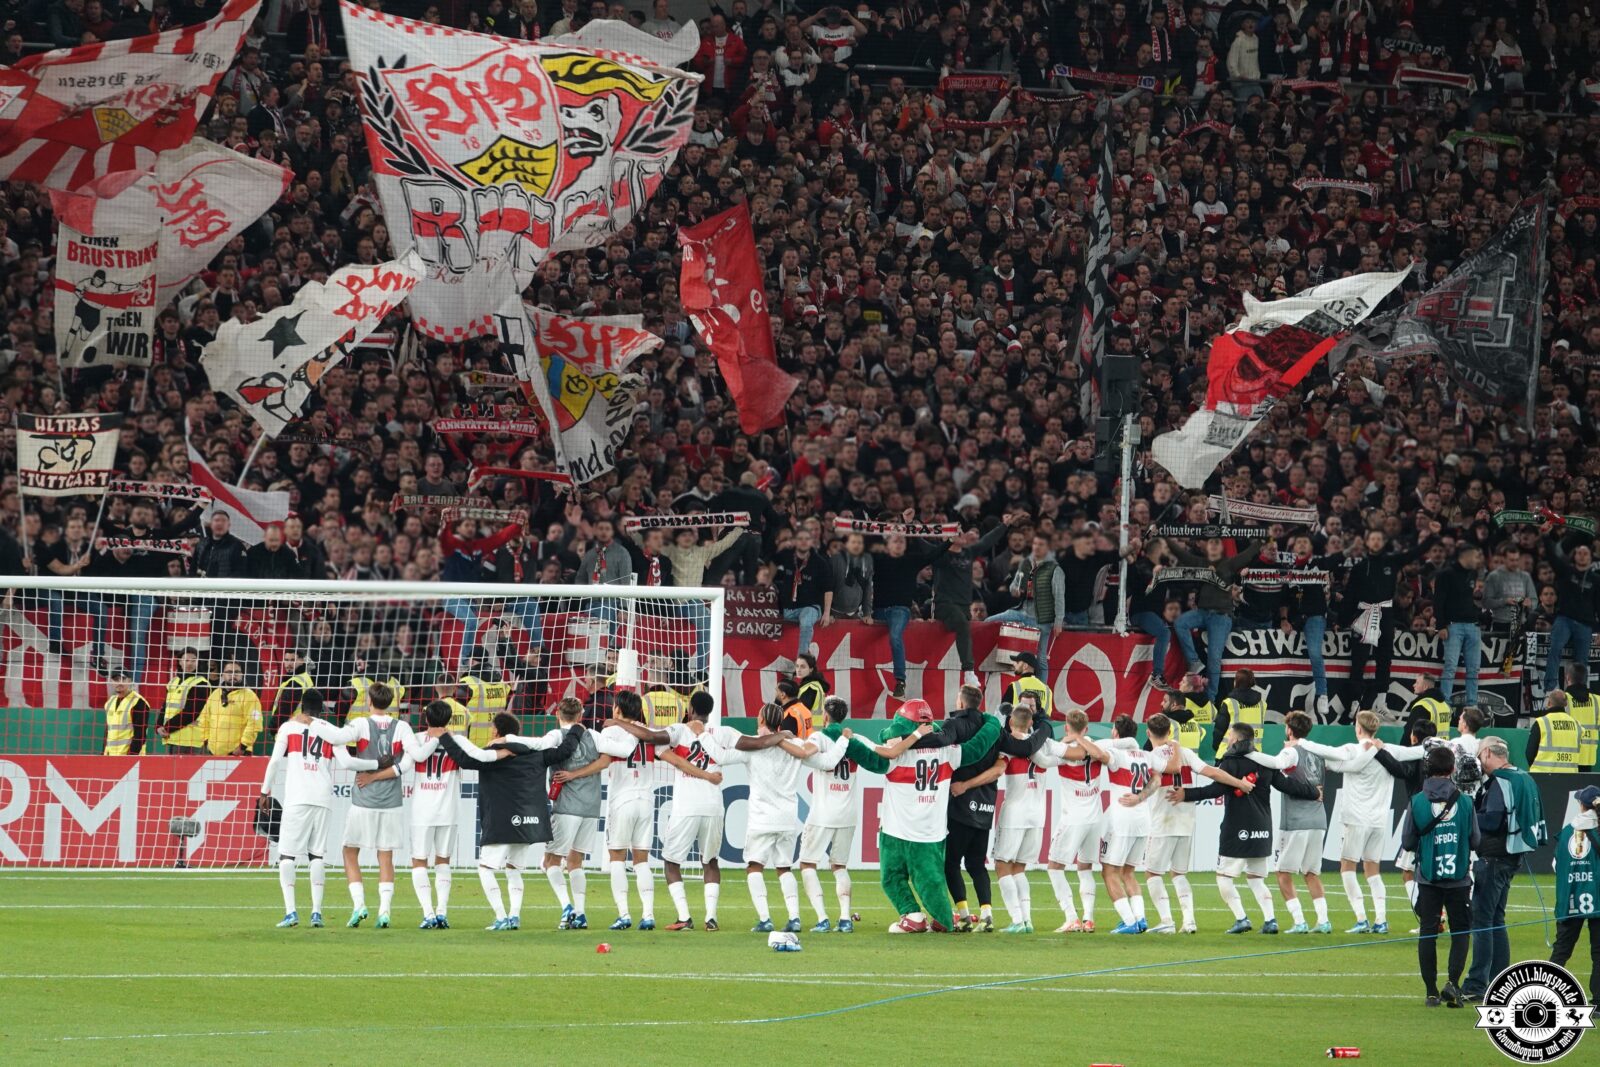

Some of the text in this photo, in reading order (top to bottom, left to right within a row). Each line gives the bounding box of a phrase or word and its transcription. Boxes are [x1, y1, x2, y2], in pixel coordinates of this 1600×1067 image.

[462, 134, 482, 151] 18
[106, 332, 148, 358] WIR
[34, 417, 101, 432] ULTRAS
[20, 472, 109, 489] STUTTGART
[640, 513, 735, 528] COMMANDO
[485, 687, 507, 700] SECURITY
[654, 705, 677, 718] SECURITY
[1552, 720, 1577, 732] SECURITY
[302, 728, 323, 762] 14
[426, 749, 446, 781] 17
[1556, 752, 1573, 763] 3693
[914, 758, 939, 791] 92
[978, 803, 994, 813] JAKO
[523, 816, 539, 824] JAKO
[1250, 831, 1270, 839] JAKO
[1435, 854, 1457, 877] 33
[1568, 892, 1595, 914] 18
